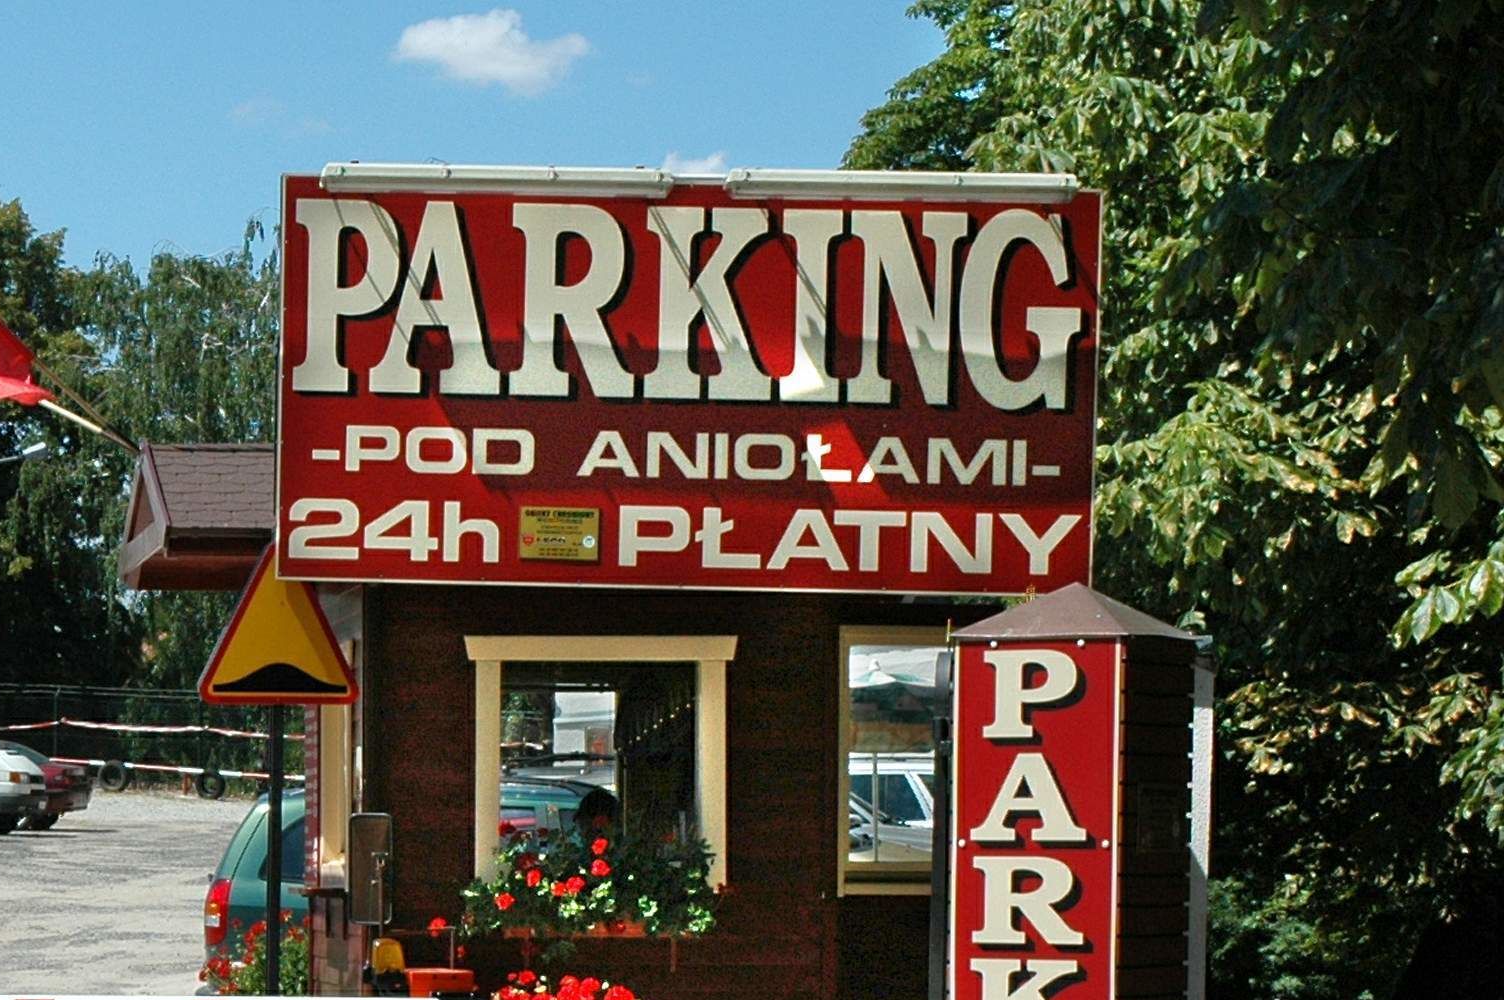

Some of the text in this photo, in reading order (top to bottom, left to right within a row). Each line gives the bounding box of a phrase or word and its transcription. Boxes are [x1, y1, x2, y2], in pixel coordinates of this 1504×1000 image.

[292, 198, 1081, 409] PARKING
[289, 498, 1082, 575] 24h PŁATNY
